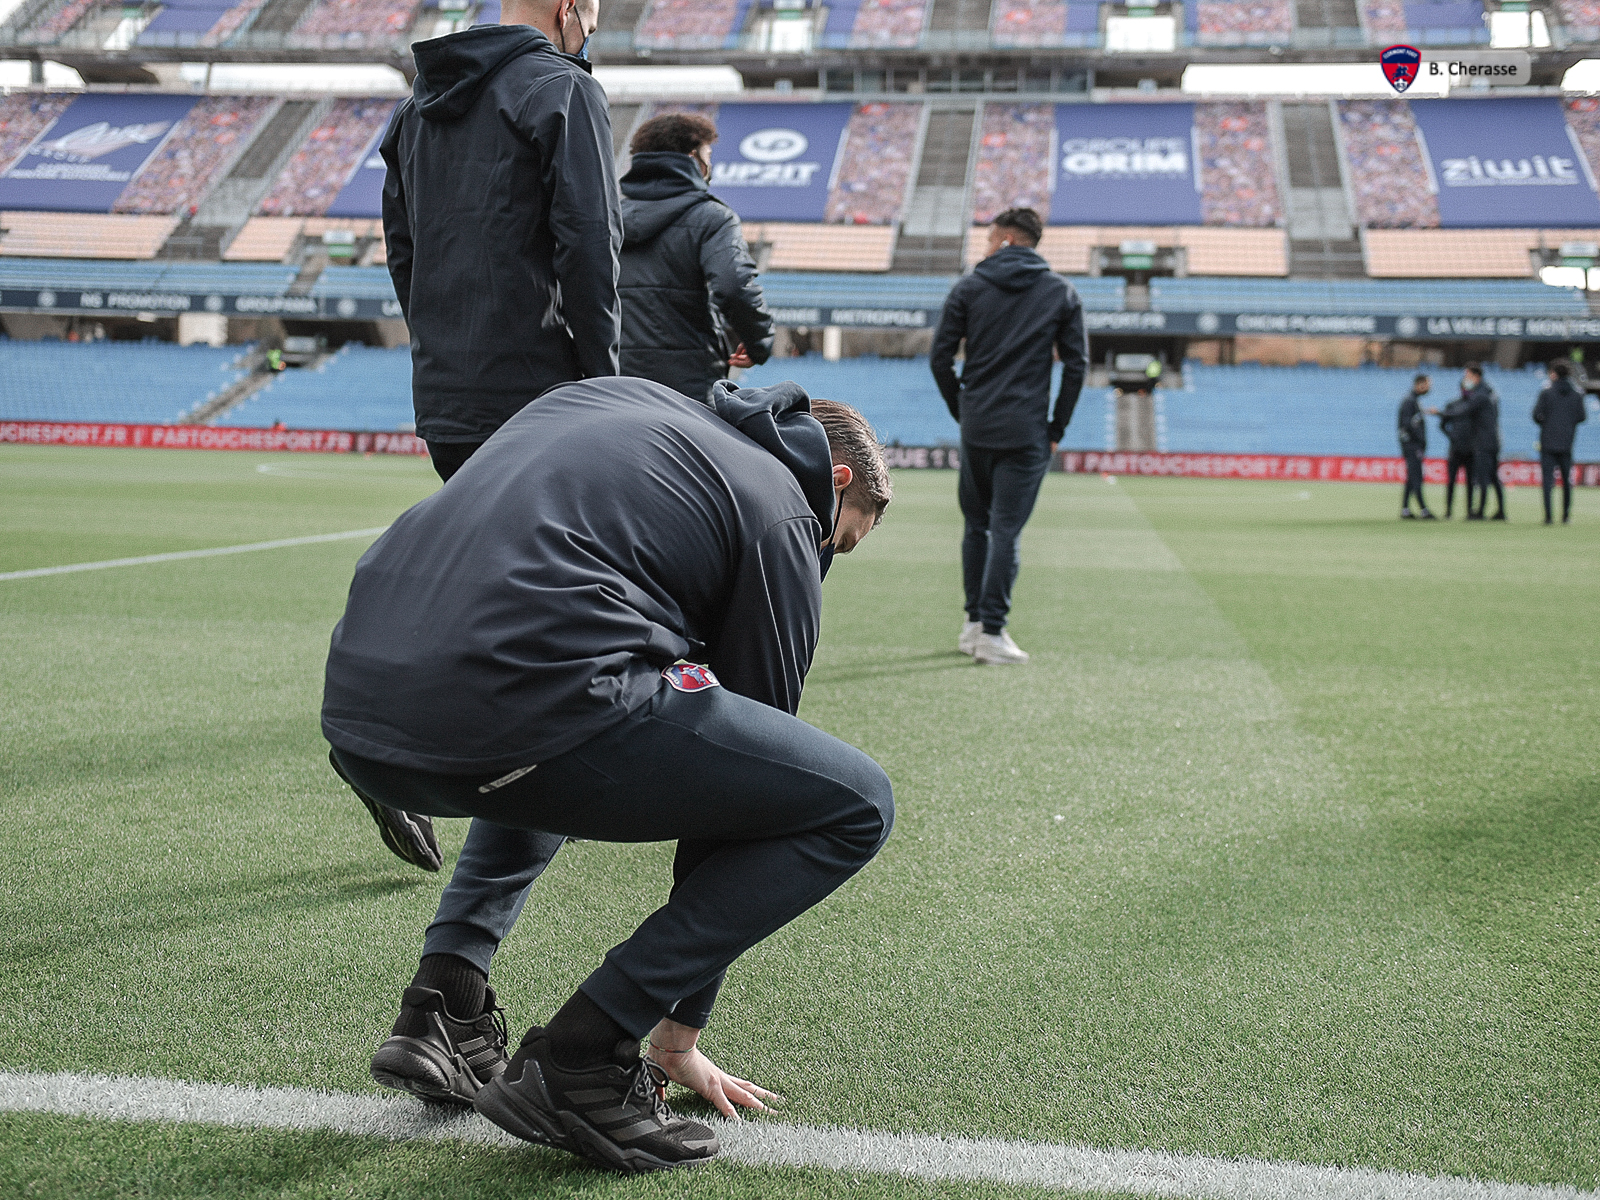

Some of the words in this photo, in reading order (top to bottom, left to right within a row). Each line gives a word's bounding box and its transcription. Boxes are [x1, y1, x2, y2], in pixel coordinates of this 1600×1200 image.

[1441, 155, 1579, 185] ziwit
[831, 309, 928, 327] METROPOLE
[1427, 317, 1450, 335] LA
[1451, 317, 1496, 335] VILLE
[1497, 317, 1523, 336] DE
[151, 427, 351, 450] PARTOUCHESPORT.FR
[1084, 453, 1312, 476] PARTOUCHESPORT.FR
